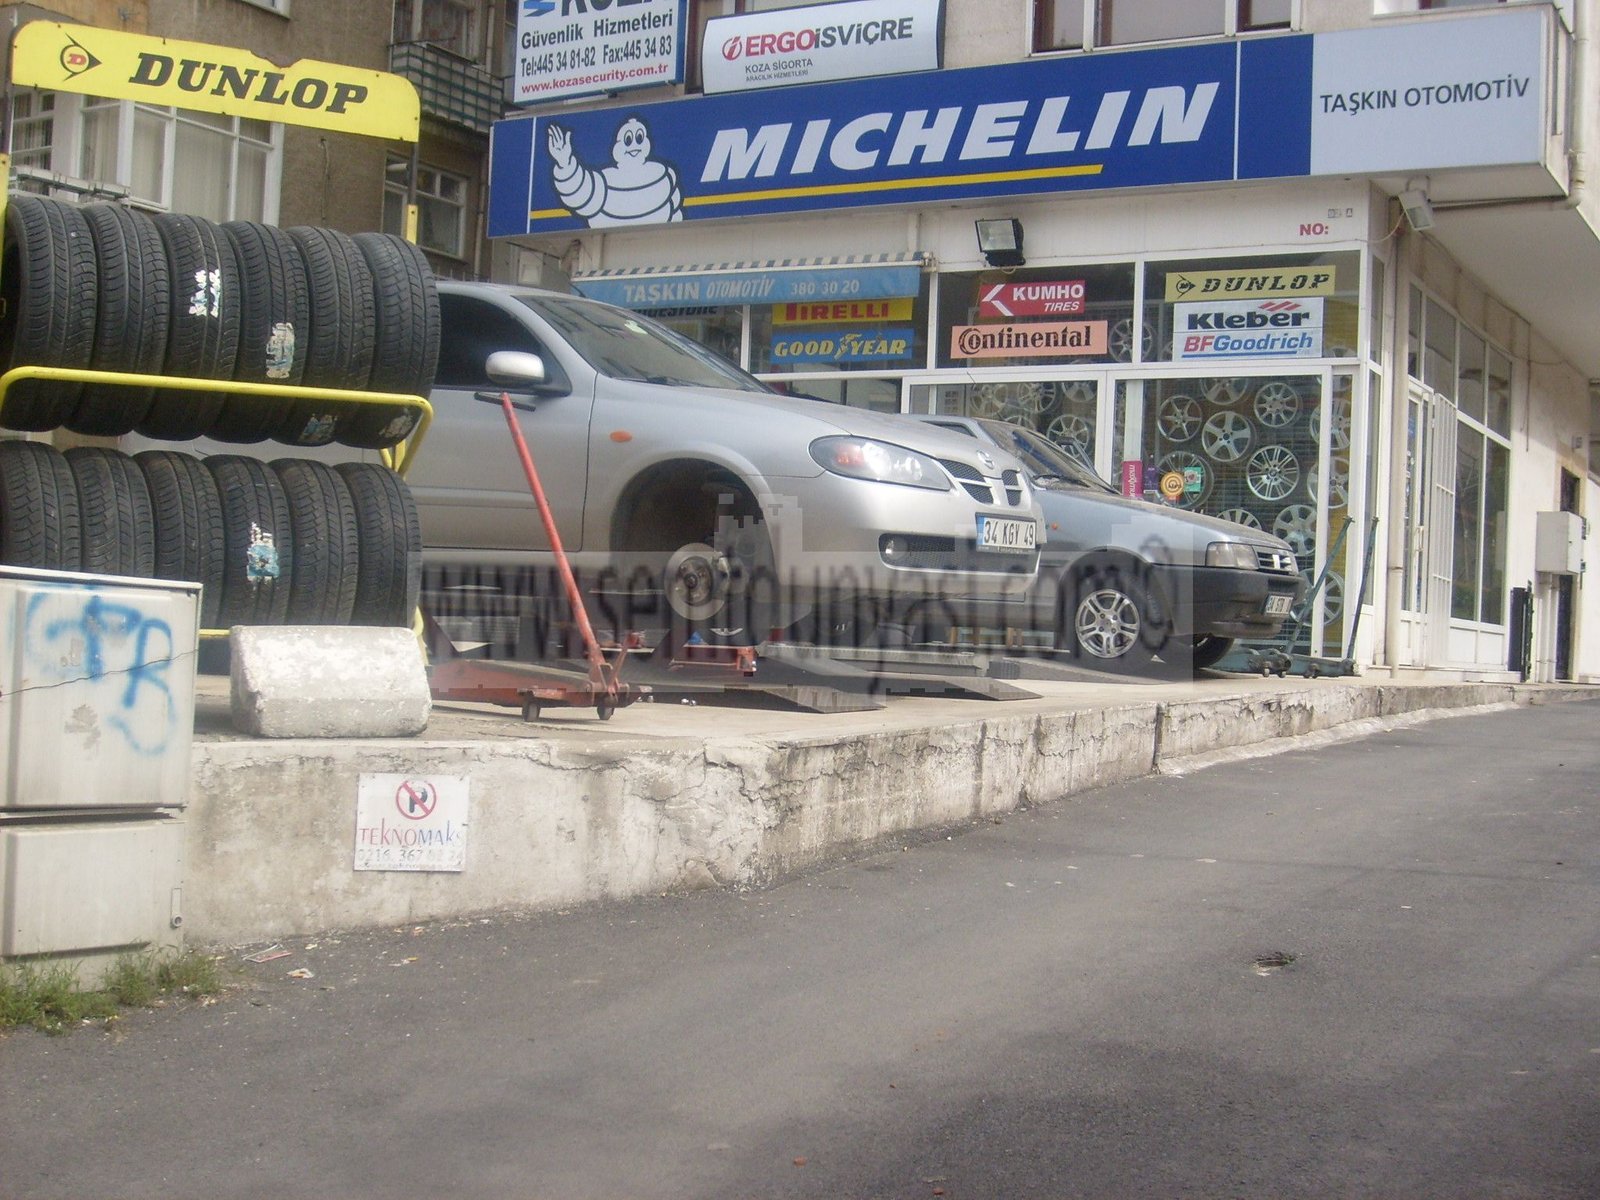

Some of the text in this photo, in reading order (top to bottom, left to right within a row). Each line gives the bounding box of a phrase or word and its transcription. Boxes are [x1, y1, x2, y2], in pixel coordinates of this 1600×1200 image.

[522, 9, 673, 49] Güvenlik Hizmetleri
[521, 35, 672, 77] Tel:445 34 81-82 Fax:445 34 83
[745, 58, 813, 74] KOZA SİGORTA
[129, 52, 368, 114] DUNLOP
[521, 63, 668, 94] www.kozasecurity.com.tr
[1320, 74, 1530, 116] TAŞKIN OTOMOTİV
[700, 82, 1220, 183] MICHELIN
[1299, 223, 1329, 236] NO:
[624, 274, 859, 304] TAŞKIN OTOMOTİV 380 30 20
[1013, 284, 1085, 301] KUMHO
[1201, 274, 1330, 293] DUNLOP
[1044, 301, 1080, 312] TIRES
[1188, 311, 1310, 330] Kleber
[958, 325, 1092, 355] Continental
[1184, 332, 1313, 353] BFGoodrich
[984, 520, 998, 544] 34
[1024, 524, 1034, 546] 49
